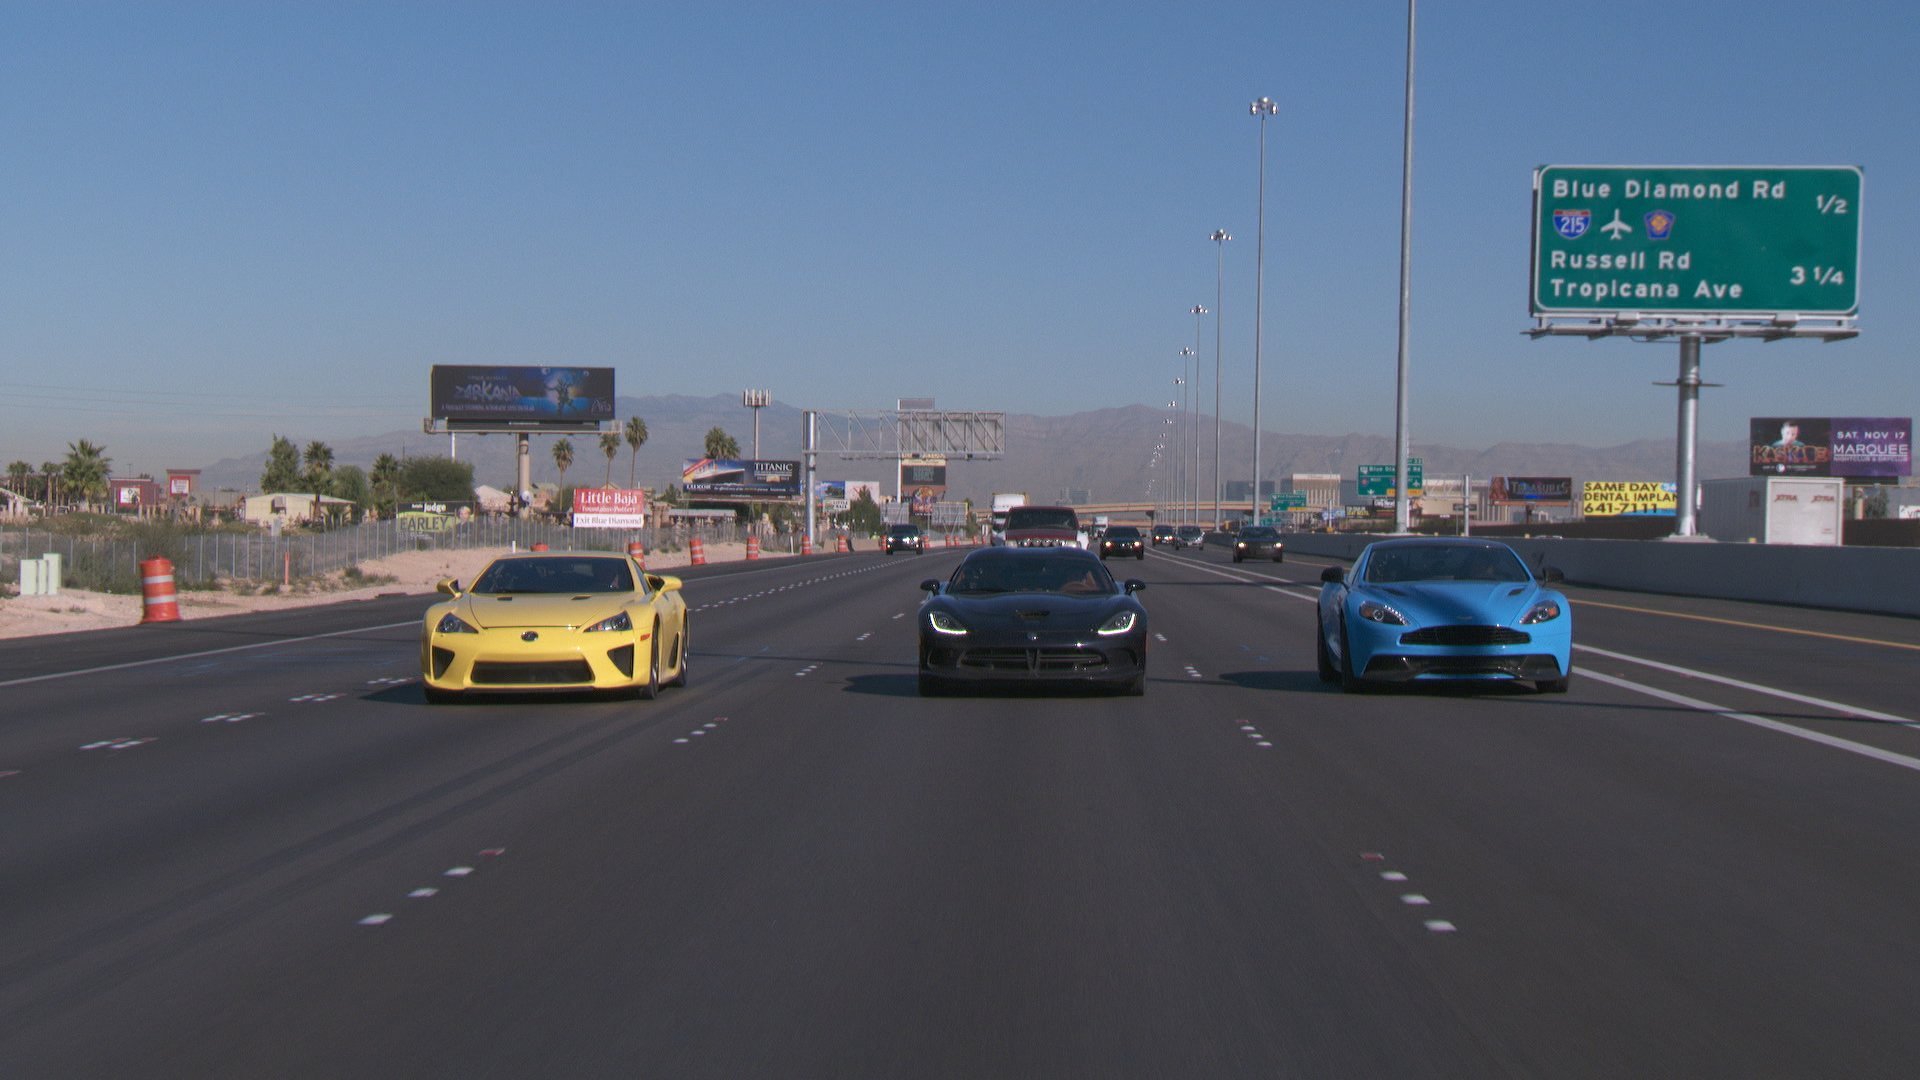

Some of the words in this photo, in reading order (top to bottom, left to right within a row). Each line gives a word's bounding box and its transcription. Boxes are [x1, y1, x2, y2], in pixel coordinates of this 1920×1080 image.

[1553, 179, 1611, 198] Blue
[1625, 179, 1739, 198] Diamond
[1752, 180, 1785, 199] Rd
[1816, 195, 1848, 214] 1/2
[1560, 216, 1586, 233] 215
[1551, 251, 1645, 269] Russell
[1659, 252, 1691, 269] Rd
[1790, 265, 1806, 285] 3
[1813, 266, 1845, 285] 1/4
[1551, 279, 1679, 301] Tropicana
[1694, 280, 1742, 298] Ave
[1864, 431, 1889, 439] NOV
[1895, 431, 1905, 439] 17
[1833, 443, 1909, 456] MARQUEE
[754, 462, 793, 471] TITANIC
[1584, 482, 1629, 492] SAME
[1629, 482, 1659, 492] DAY
[581, 491, 611, 504] Little
[614, 491, 638, 506] Baja
[1584, 493, 1630, 501] DENTAL
[1584, 503, 1658, 513] 641-7111
